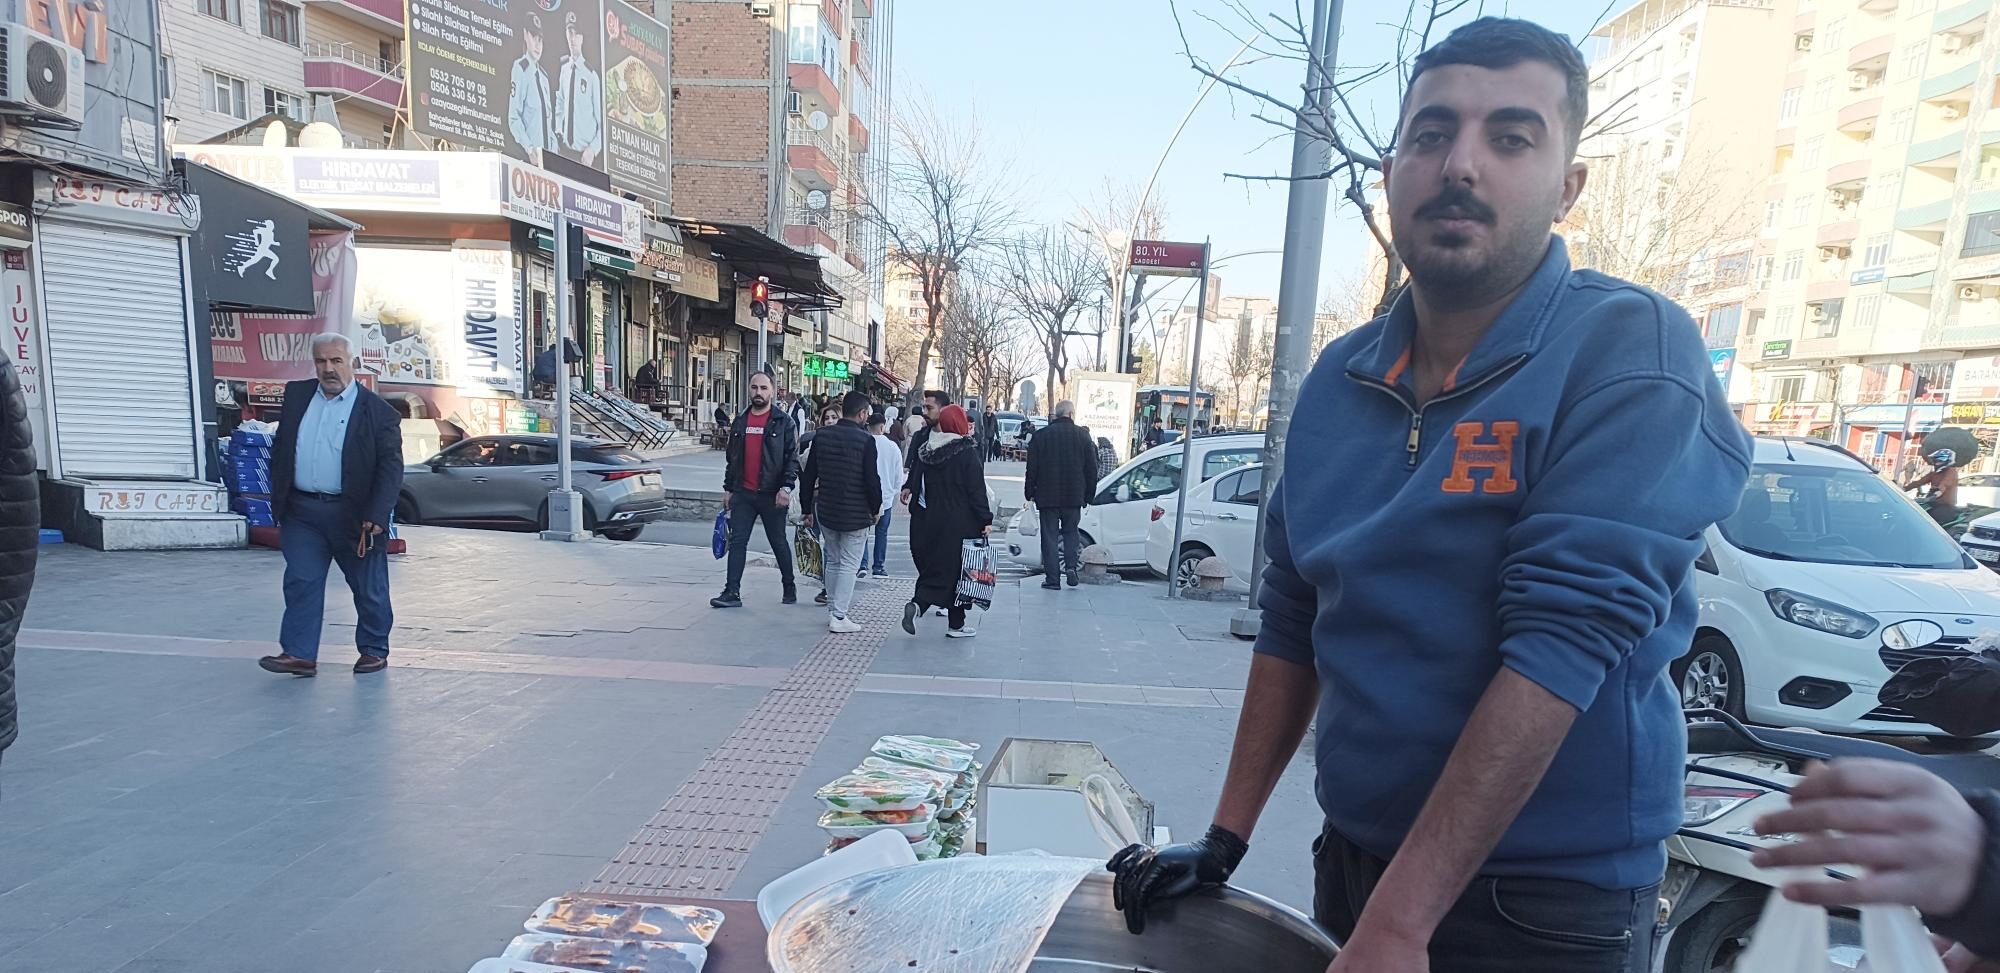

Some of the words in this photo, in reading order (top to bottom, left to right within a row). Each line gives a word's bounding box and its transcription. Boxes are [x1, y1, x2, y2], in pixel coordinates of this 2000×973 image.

[421, 6, 443, 24] Silahlı
[471, 26, 502, 46] Yenileme
[421, 21, 440, 38] Silah
[470, 10, 491, 29] Temel
[492, 20, 513, 37] Eğitim
[417, 40, 435, 54] KOLAY
[436, 45, 456, 61] ÖDEME
[430, 67, 449, 83] 0532
[451, 74, 465, 88] 705
[466, 79, 476, 92] 09
[477, 83, 487, 95] 08
[430, 80, 450, 95] 0506
[451, 86, 466, 101] 330
[467, 91, 477, 104] 56
[478, 95, 487, 108] 72
[611, 126, 640, 150] BATMAN
[640, 138, 660, 158] HALKI
[619, 146, 636, 161] TERCİH
[321, 160, 411, 180] HIRDAVAT
[616, 158, 640, 175] TEŞEKKÜR
[512, 167, 561, 210] ONUR
[575, 193, 612, 218] HIRDAVAT
[1135, 245, 1150, 256] 80.
[1152, 246, 1168, 257] YIL
[685, 258, 717, 281] OÇER
[12, 285, 29, 360] JUVE
[465, 278, 498, 372] HIRDAVAT
[513, 288, 523, 374] HIRDAVAT
[1441, 421, 1519, 494] H
[154, 493, 212, 512] CAFE
